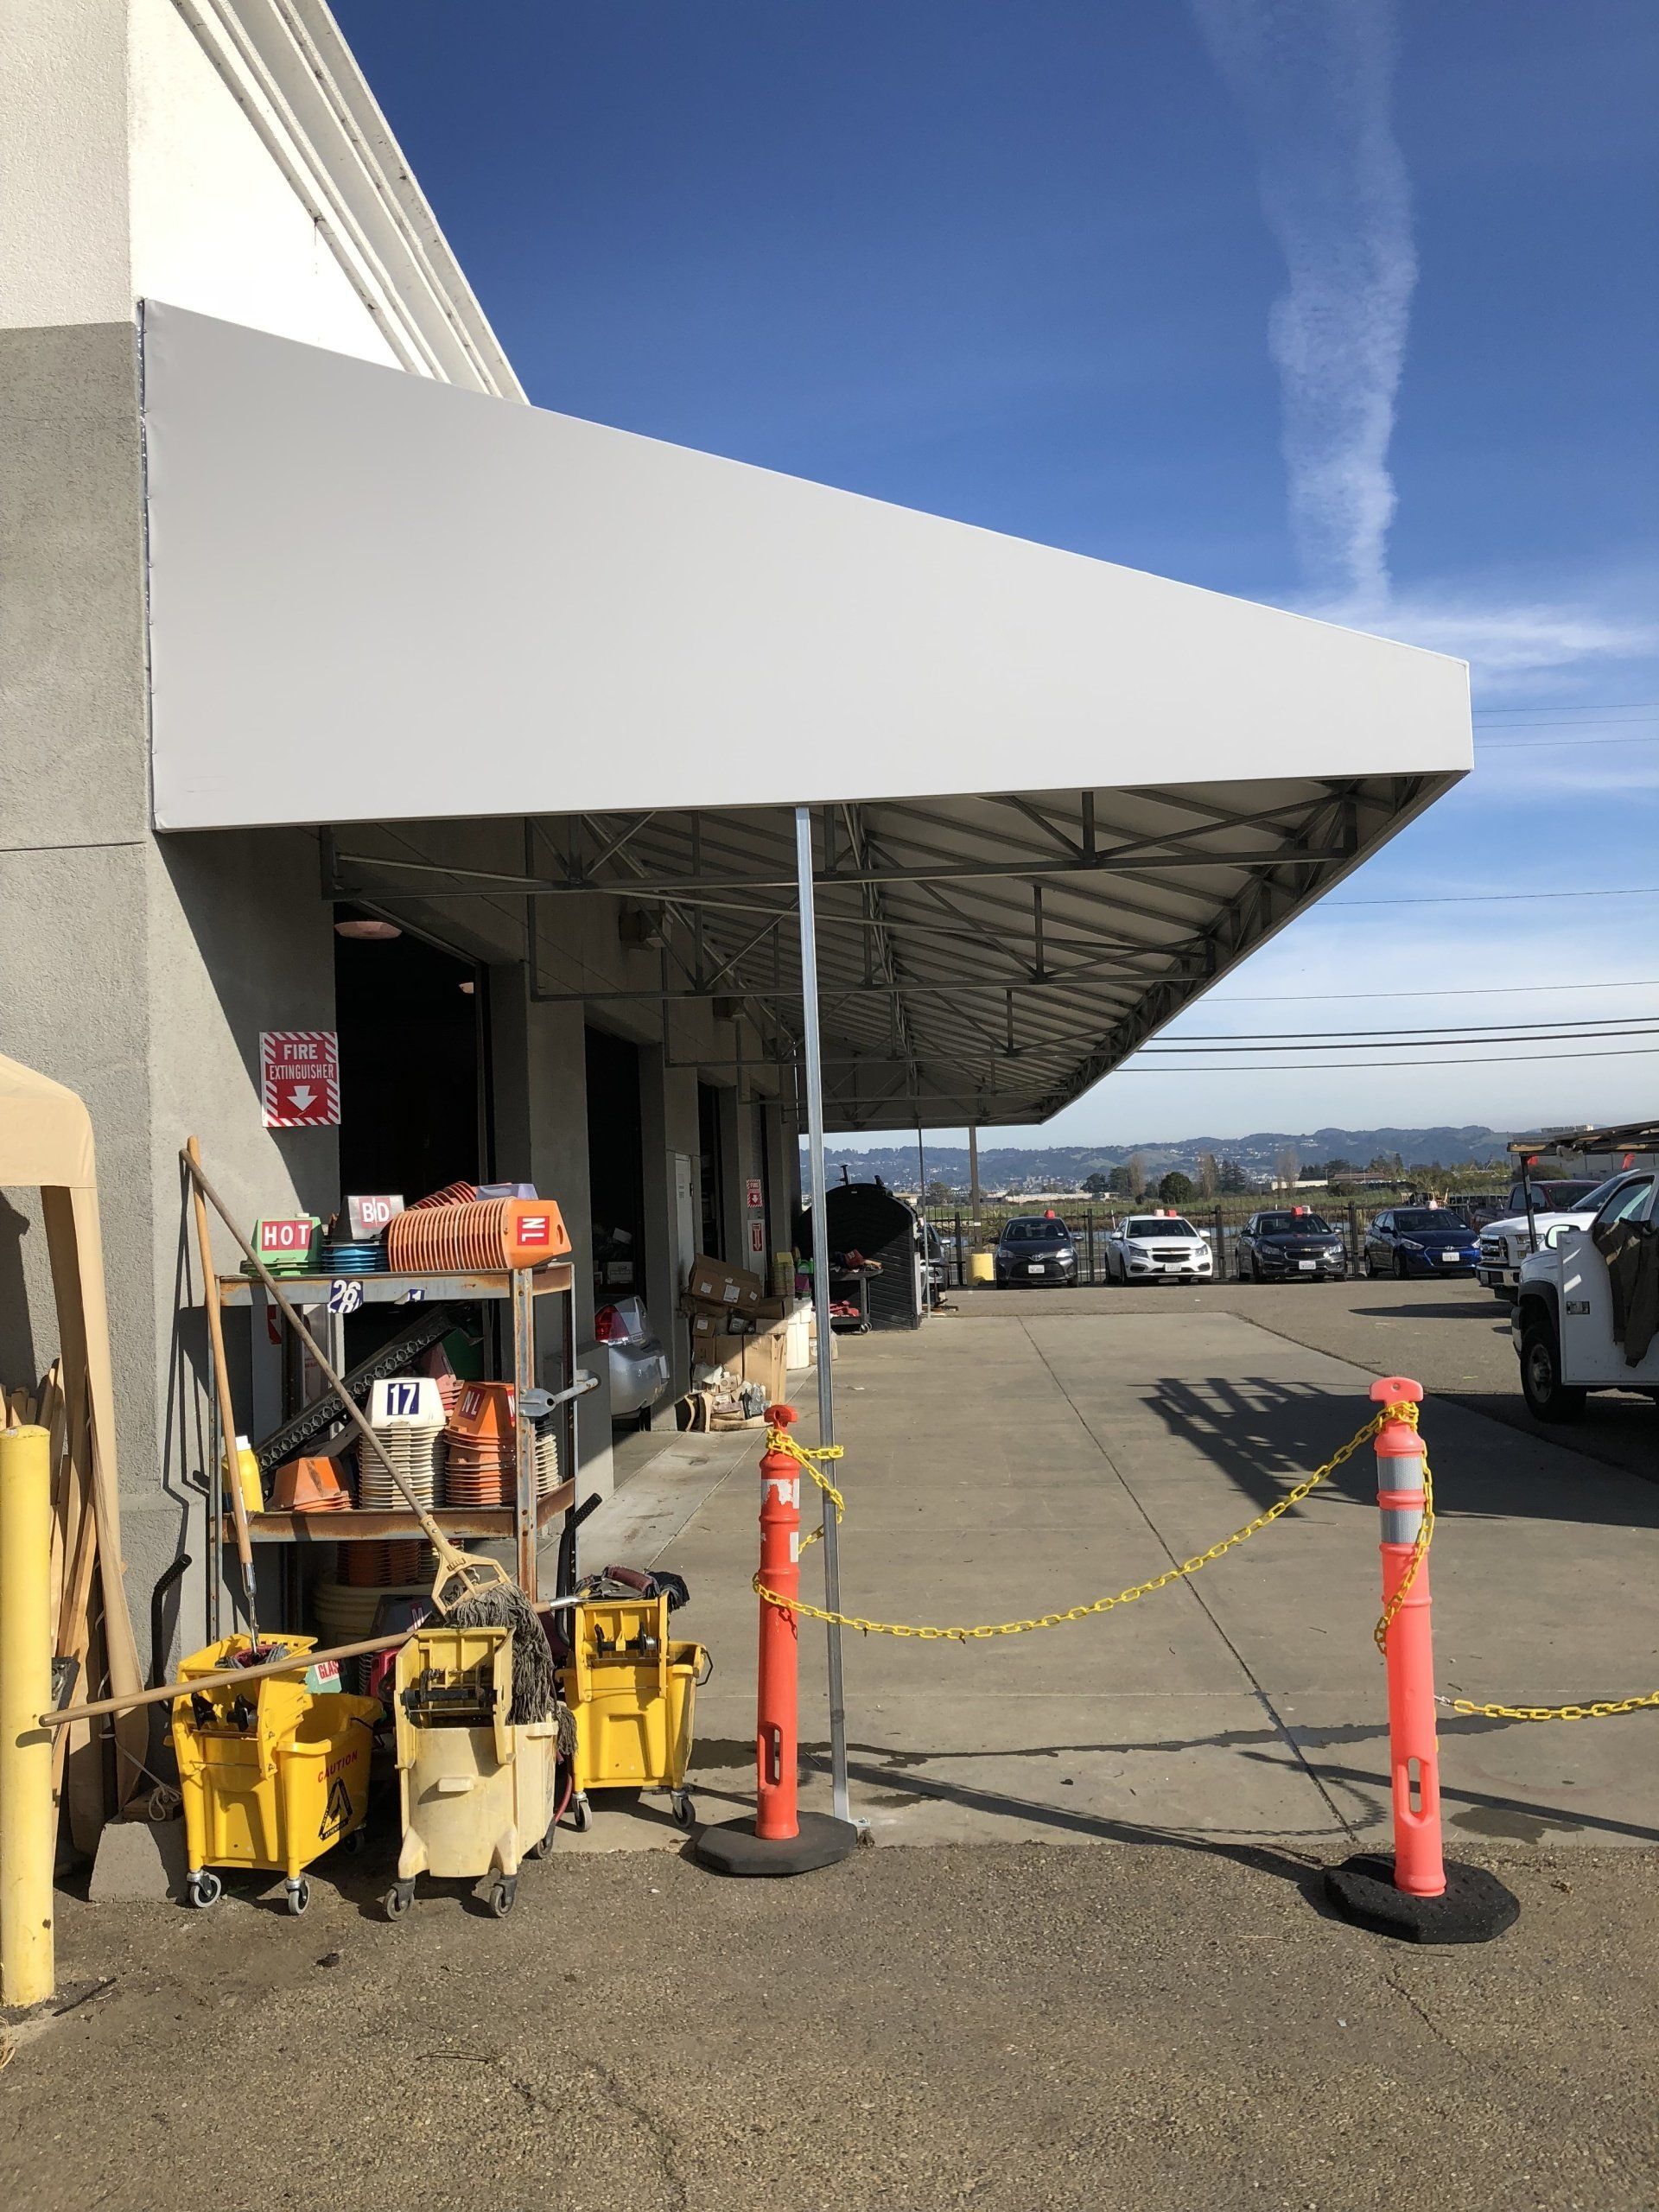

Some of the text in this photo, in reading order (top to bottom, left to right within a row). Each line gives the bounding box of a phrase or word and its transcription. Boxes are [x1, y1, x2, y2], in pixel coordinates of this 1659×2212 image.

[283, 1044, 318, 1060] FIRE
[269, 1064, 334, 1081] EXTINGUISHER
[264, 1224, 309, 1247] HOT
[521, 1217, 546, 1243] NL
[390, 1383, 416, 1415] 17
[461, 1391, 480, 1415] NL
[318, 1750, 358, 1783] CAUTION
